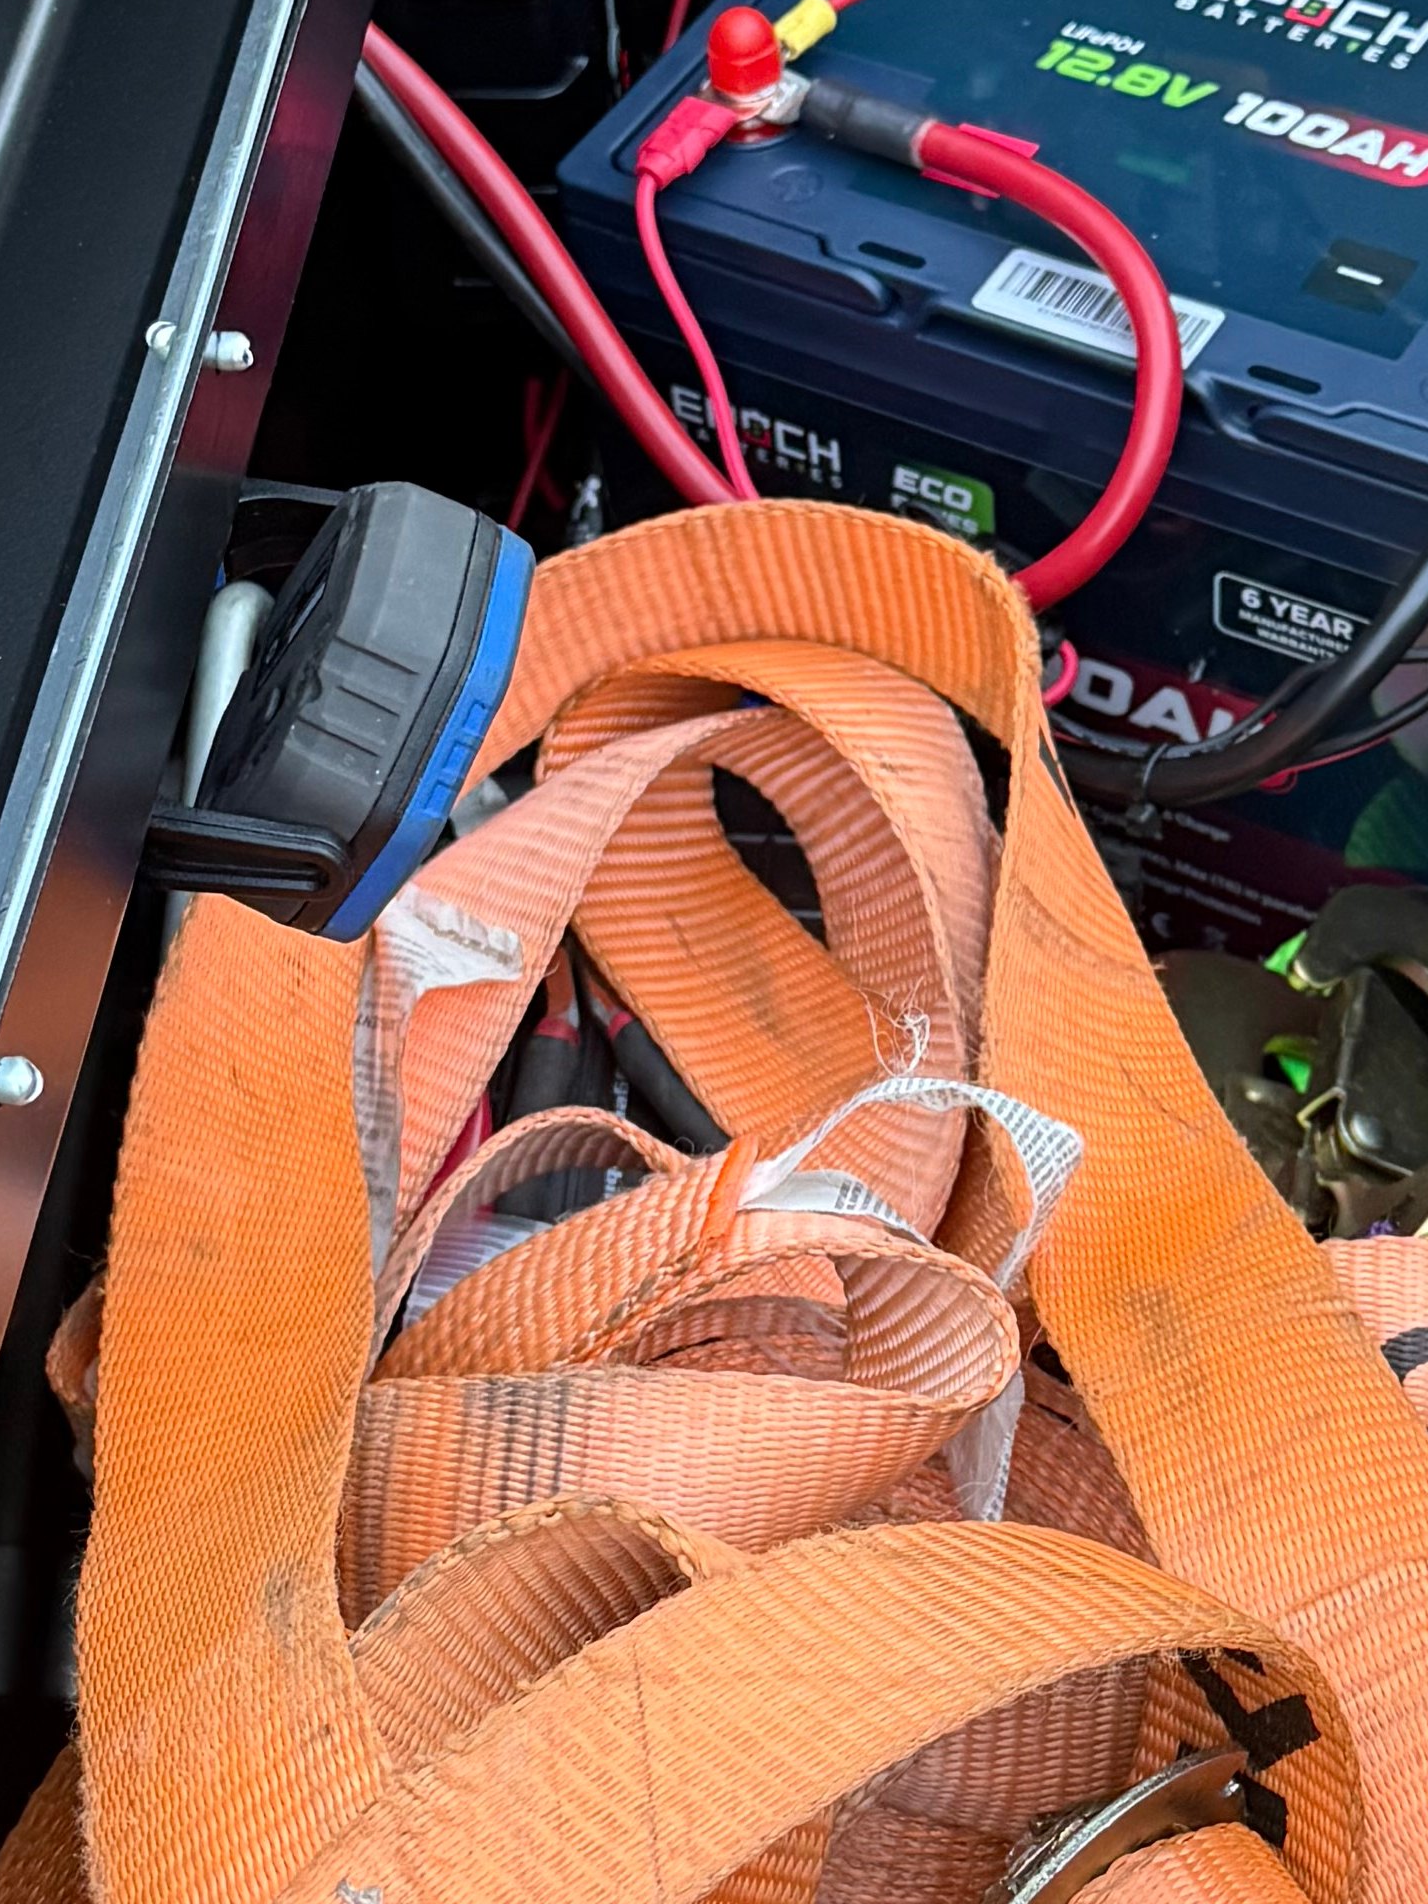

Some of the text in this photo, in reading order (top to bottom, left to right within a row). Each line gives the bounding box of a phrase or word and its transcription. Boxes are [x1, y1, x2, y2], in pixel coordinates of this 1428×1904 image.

[1035, 39, 1221, 108] 12.8V
[893, 464, 973, 513] ECO
[1238, 609, 1350, 653] MANUFACTURE
[1240, 587, 1354, 640] 6 YEAR
